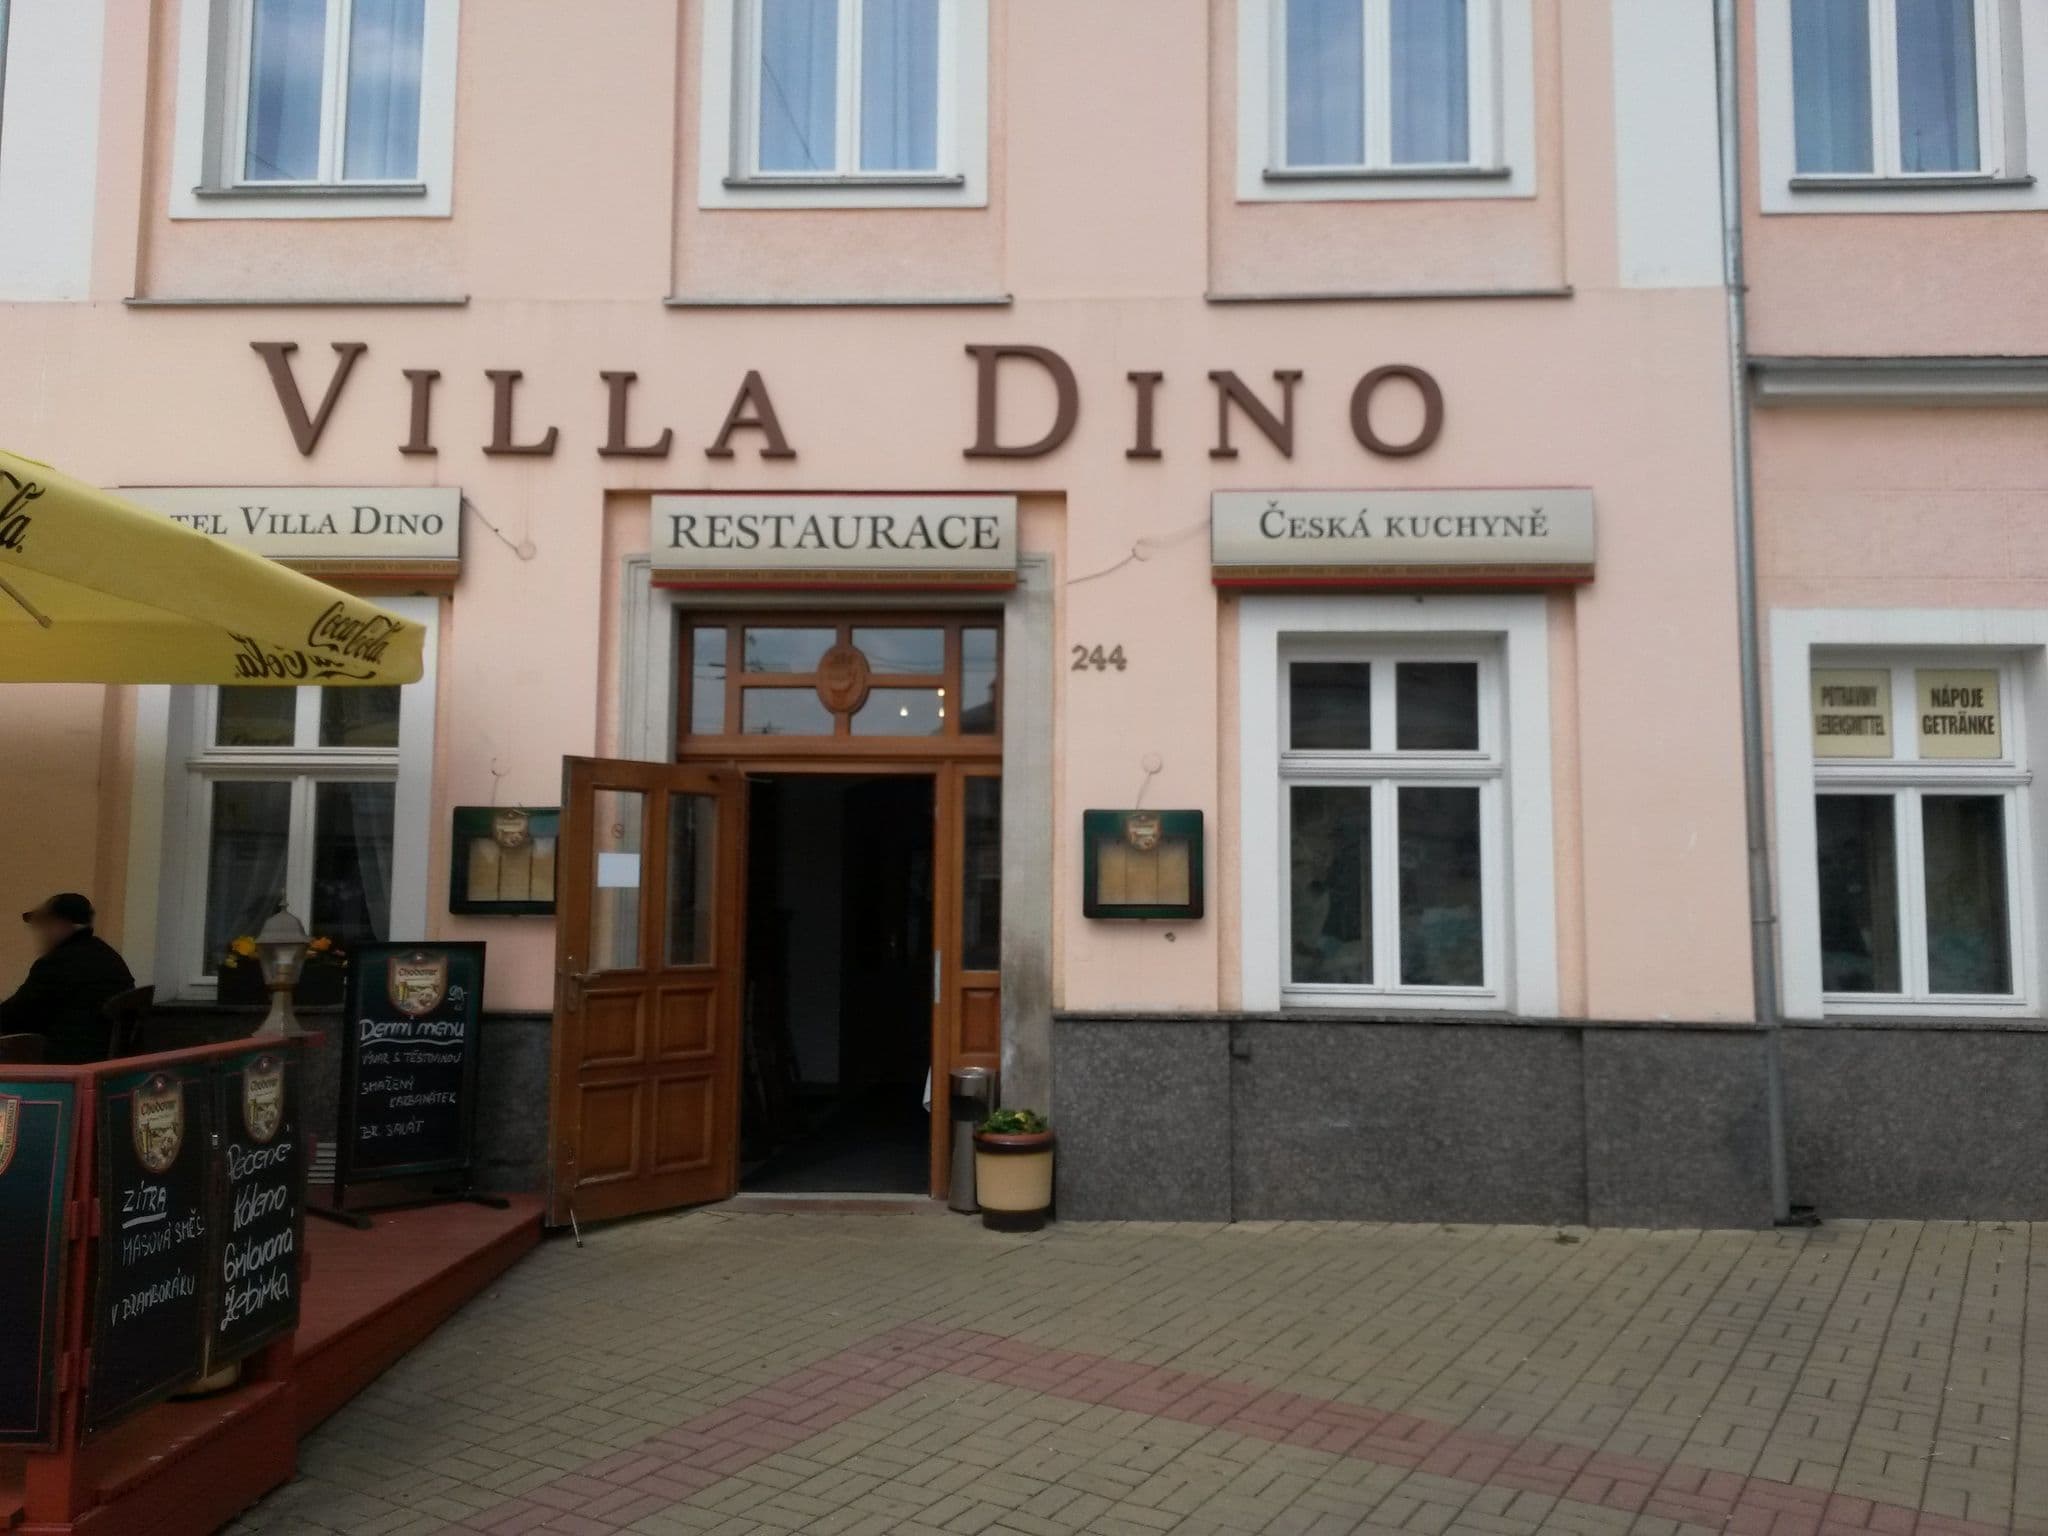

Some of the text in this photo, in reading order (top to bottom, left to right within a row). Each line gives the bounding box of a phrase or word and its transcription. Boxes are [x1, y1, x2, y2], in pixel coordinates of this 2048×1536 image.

[250, 341, 1446, 460] VILLA DINO
[239, 505, 338, 535] VILLA
[351, 505, 444, 536] DINO
[668, 513, 1000, 551] RESTAURACE
[1259, 500, 1550, 539] ČESKÁ KUCHYNĚ
[1071, 645, 1128, 671] 244
[1931, 684, 1984, 708] NÁPOJE
[1922, 711, 1995, 735] GETRÄNKE
[416, 1021, 465, 1037] menu
[123, 1180, 167, 1212] ZÍTRA
